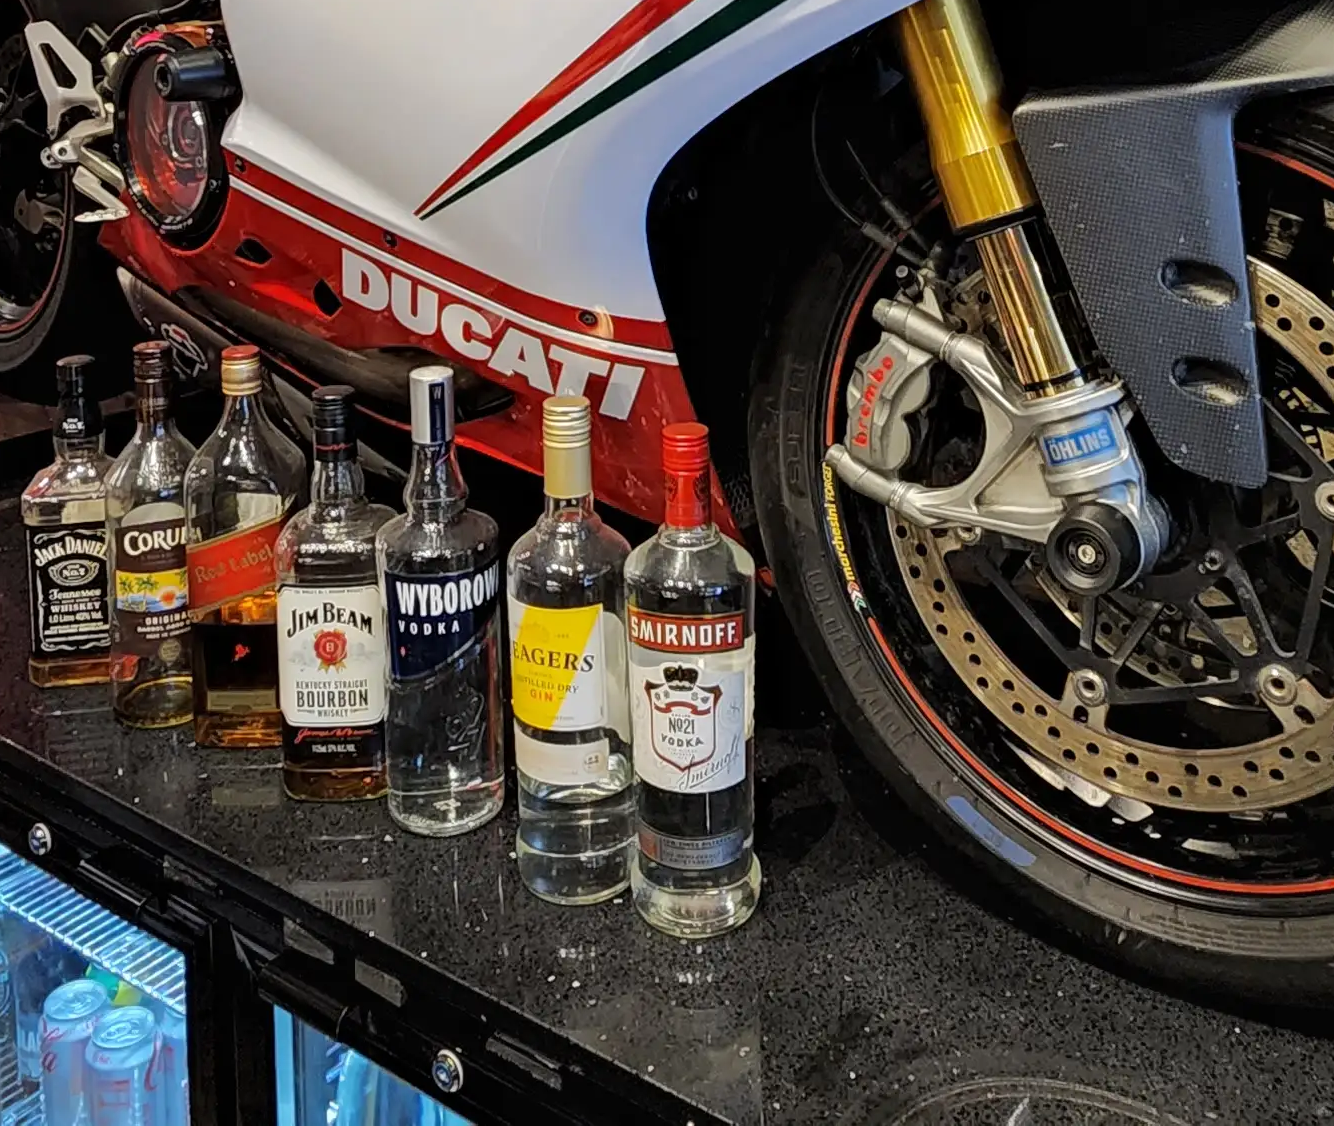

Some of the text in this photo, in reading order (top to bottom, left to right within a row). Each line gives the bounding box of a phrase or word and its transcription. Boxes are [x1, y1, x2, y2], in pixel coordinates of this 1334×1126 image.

[341, 248, 646, 421] DUCATI
[851, 355, 894, 448] brembo
[33, 536, 108, 567] JACK DANIEL
[823, 501, 856, 582] marchesini
[228, 543, 273, 572] Label
[395, 561, 500, 617] WYBOROW
[145, 611, 188, 626] ORIGINA
[287, 602, 375, 638] JIM BEAM
[398, 620, 460, 635] VODKA
[630, 615, 737, 647] SMIRNOFF
[513, 640, 595, 673] EAGERS
[296, 689, 369, 708] BOURBON
[530, 690, 554, 703] GIN
[557, 684, 579, 694] DRY
[660, 732, 704, 748] VODKA
